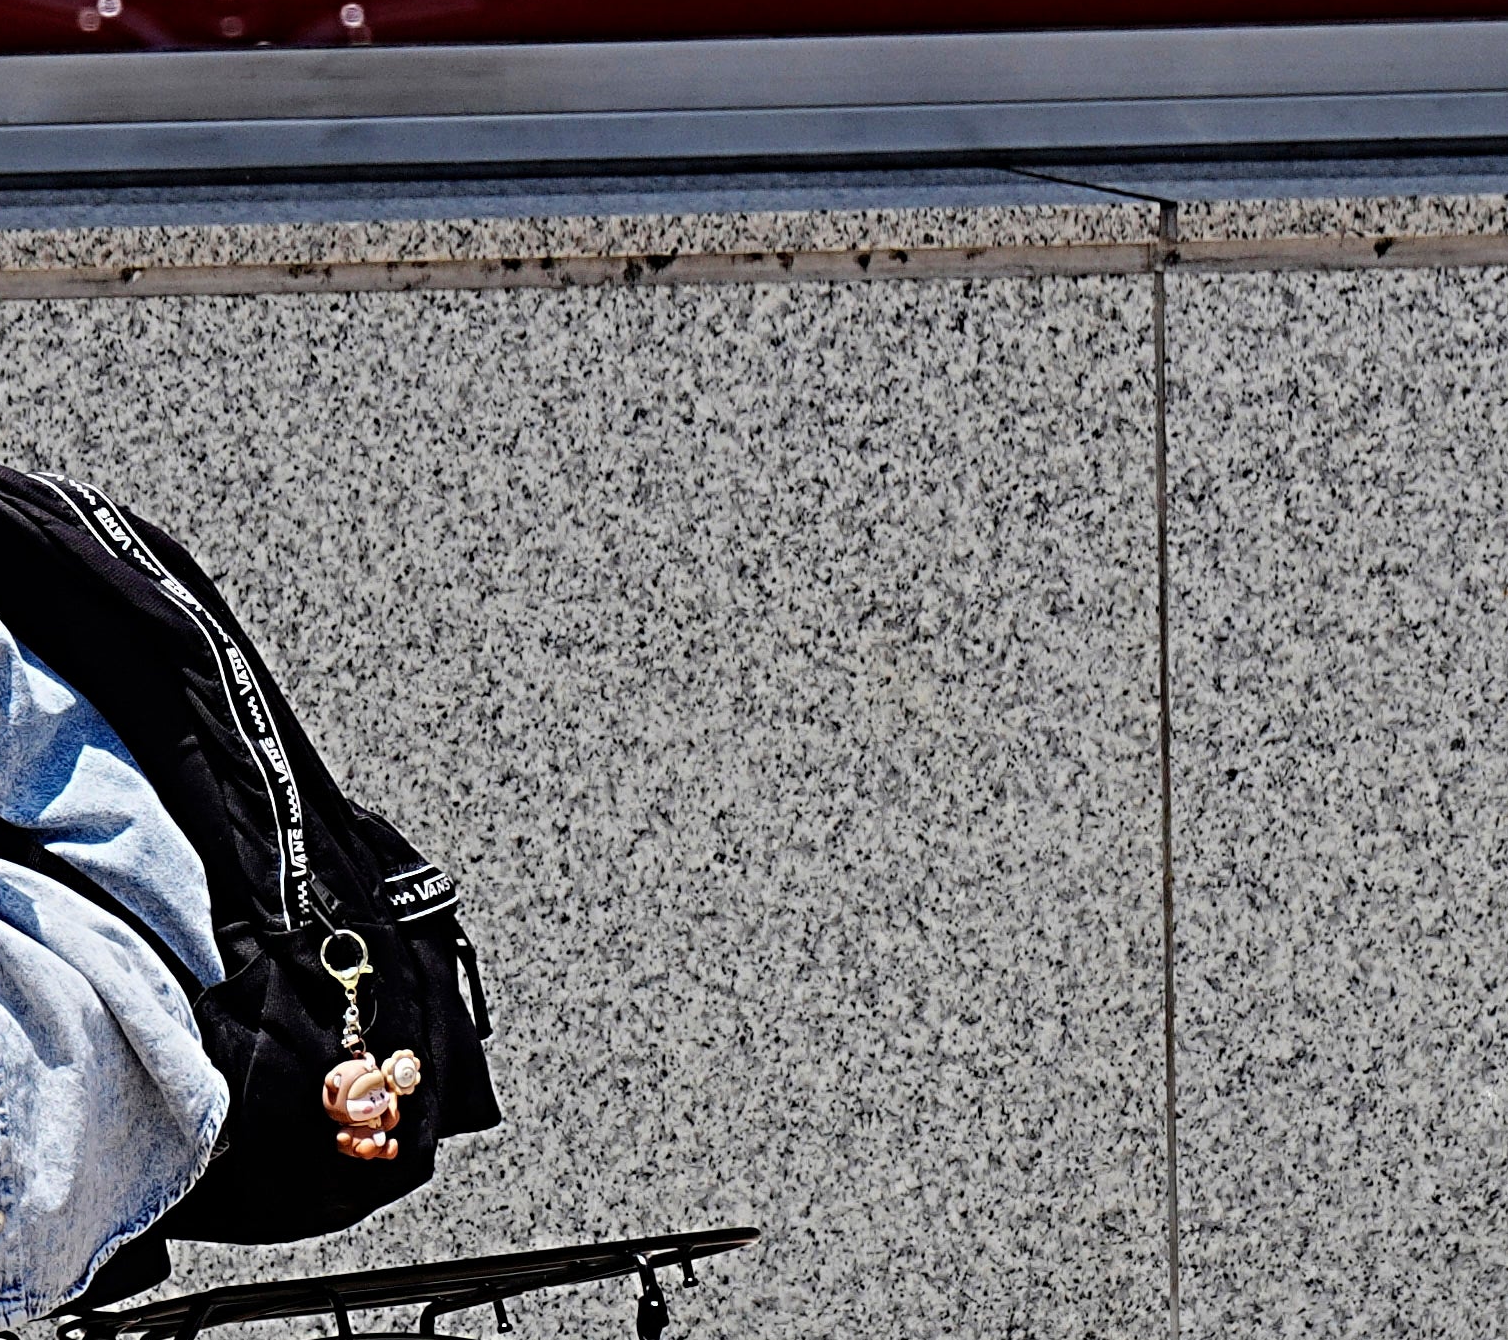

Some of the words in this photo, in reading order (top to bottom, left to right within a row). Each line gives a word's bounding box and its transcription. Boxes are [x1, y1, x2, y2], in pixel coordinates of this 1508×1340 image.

[225, 647, 253, 696] VANS
[258, 736, 291, 784] VANS
[287, 828, 308, 878] VANS
[413, 872, 451, 901] VANS
